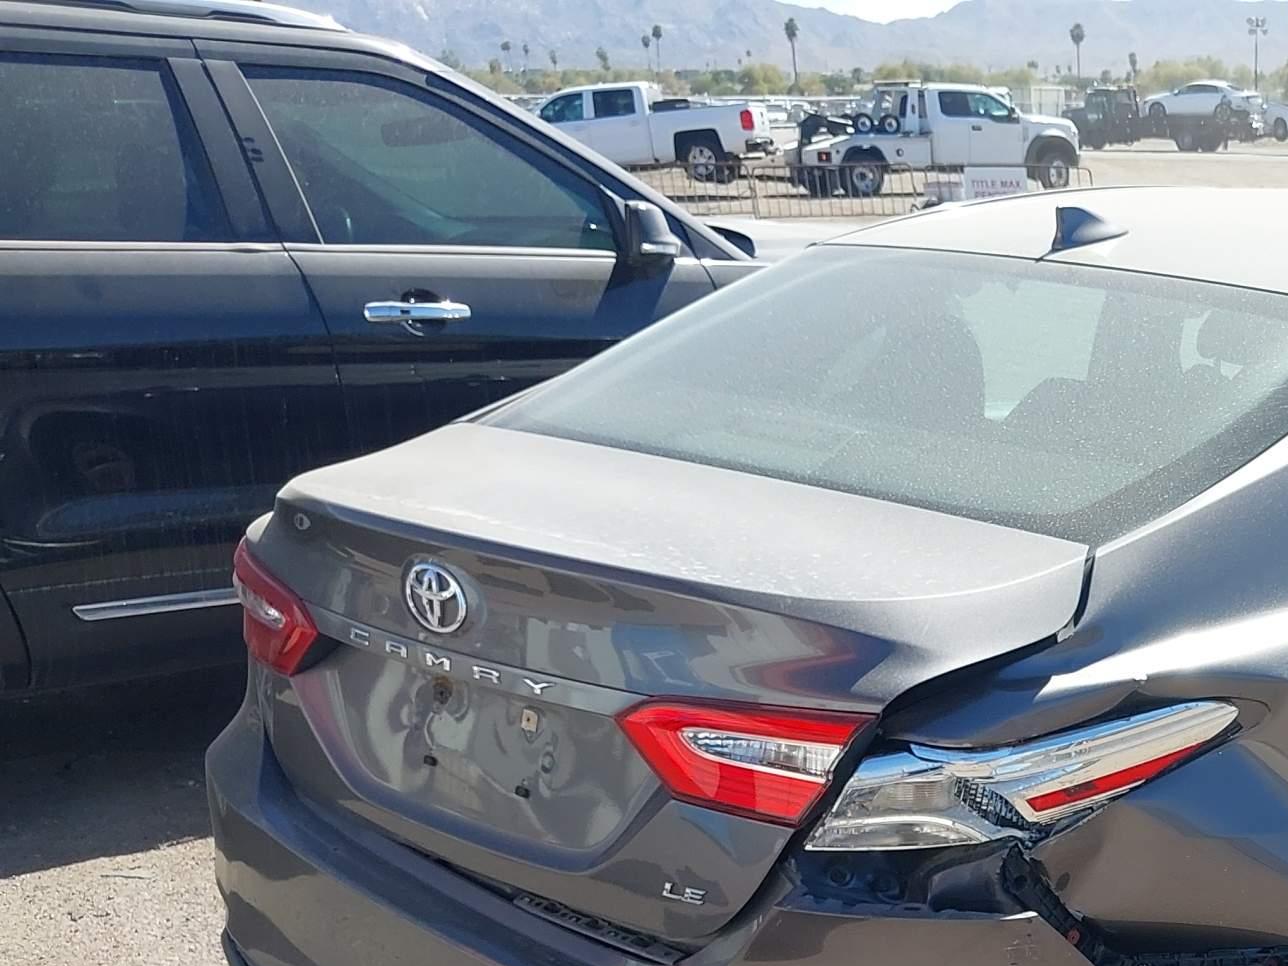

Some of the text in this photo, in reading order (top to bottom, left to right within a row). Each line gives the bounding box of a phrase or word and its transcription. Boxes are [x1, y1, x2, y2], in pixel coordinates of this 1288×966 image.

[972, 180, 1022, 188] TITLE MAX
[350, 627, 556, 695] CAMRY
[662, 882, 706, 905] LE
